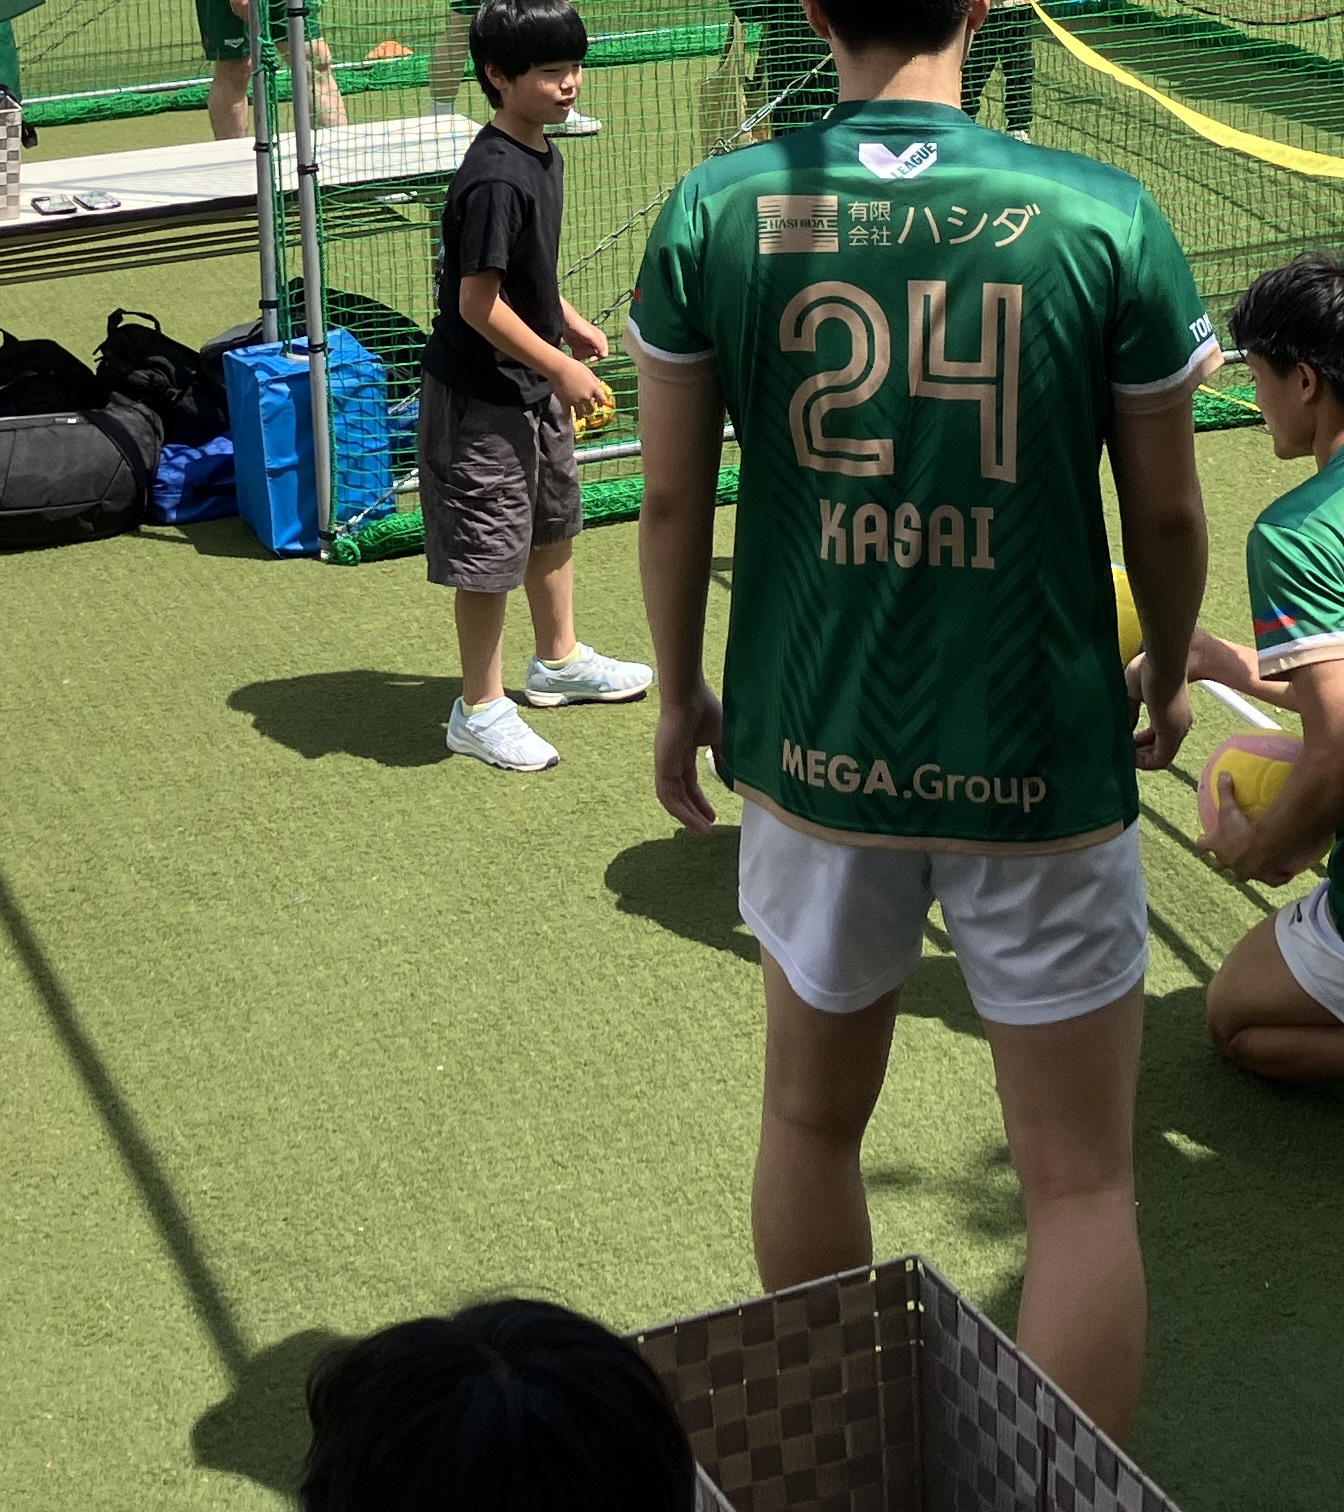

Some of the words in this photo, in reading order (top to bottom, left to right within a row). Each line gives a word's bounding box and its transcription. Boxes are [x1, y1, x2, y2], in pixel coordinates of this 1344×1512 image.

[889, 143, 937, 179] LEAGUE
[847, 201, 891, 223] 有限
[897, 203, 1041, 248] ハシダ
[848, 226, 892, 247] 会社
[778, 280, 1023, 484] 24
[818, 498, 996, 570] KASAI
